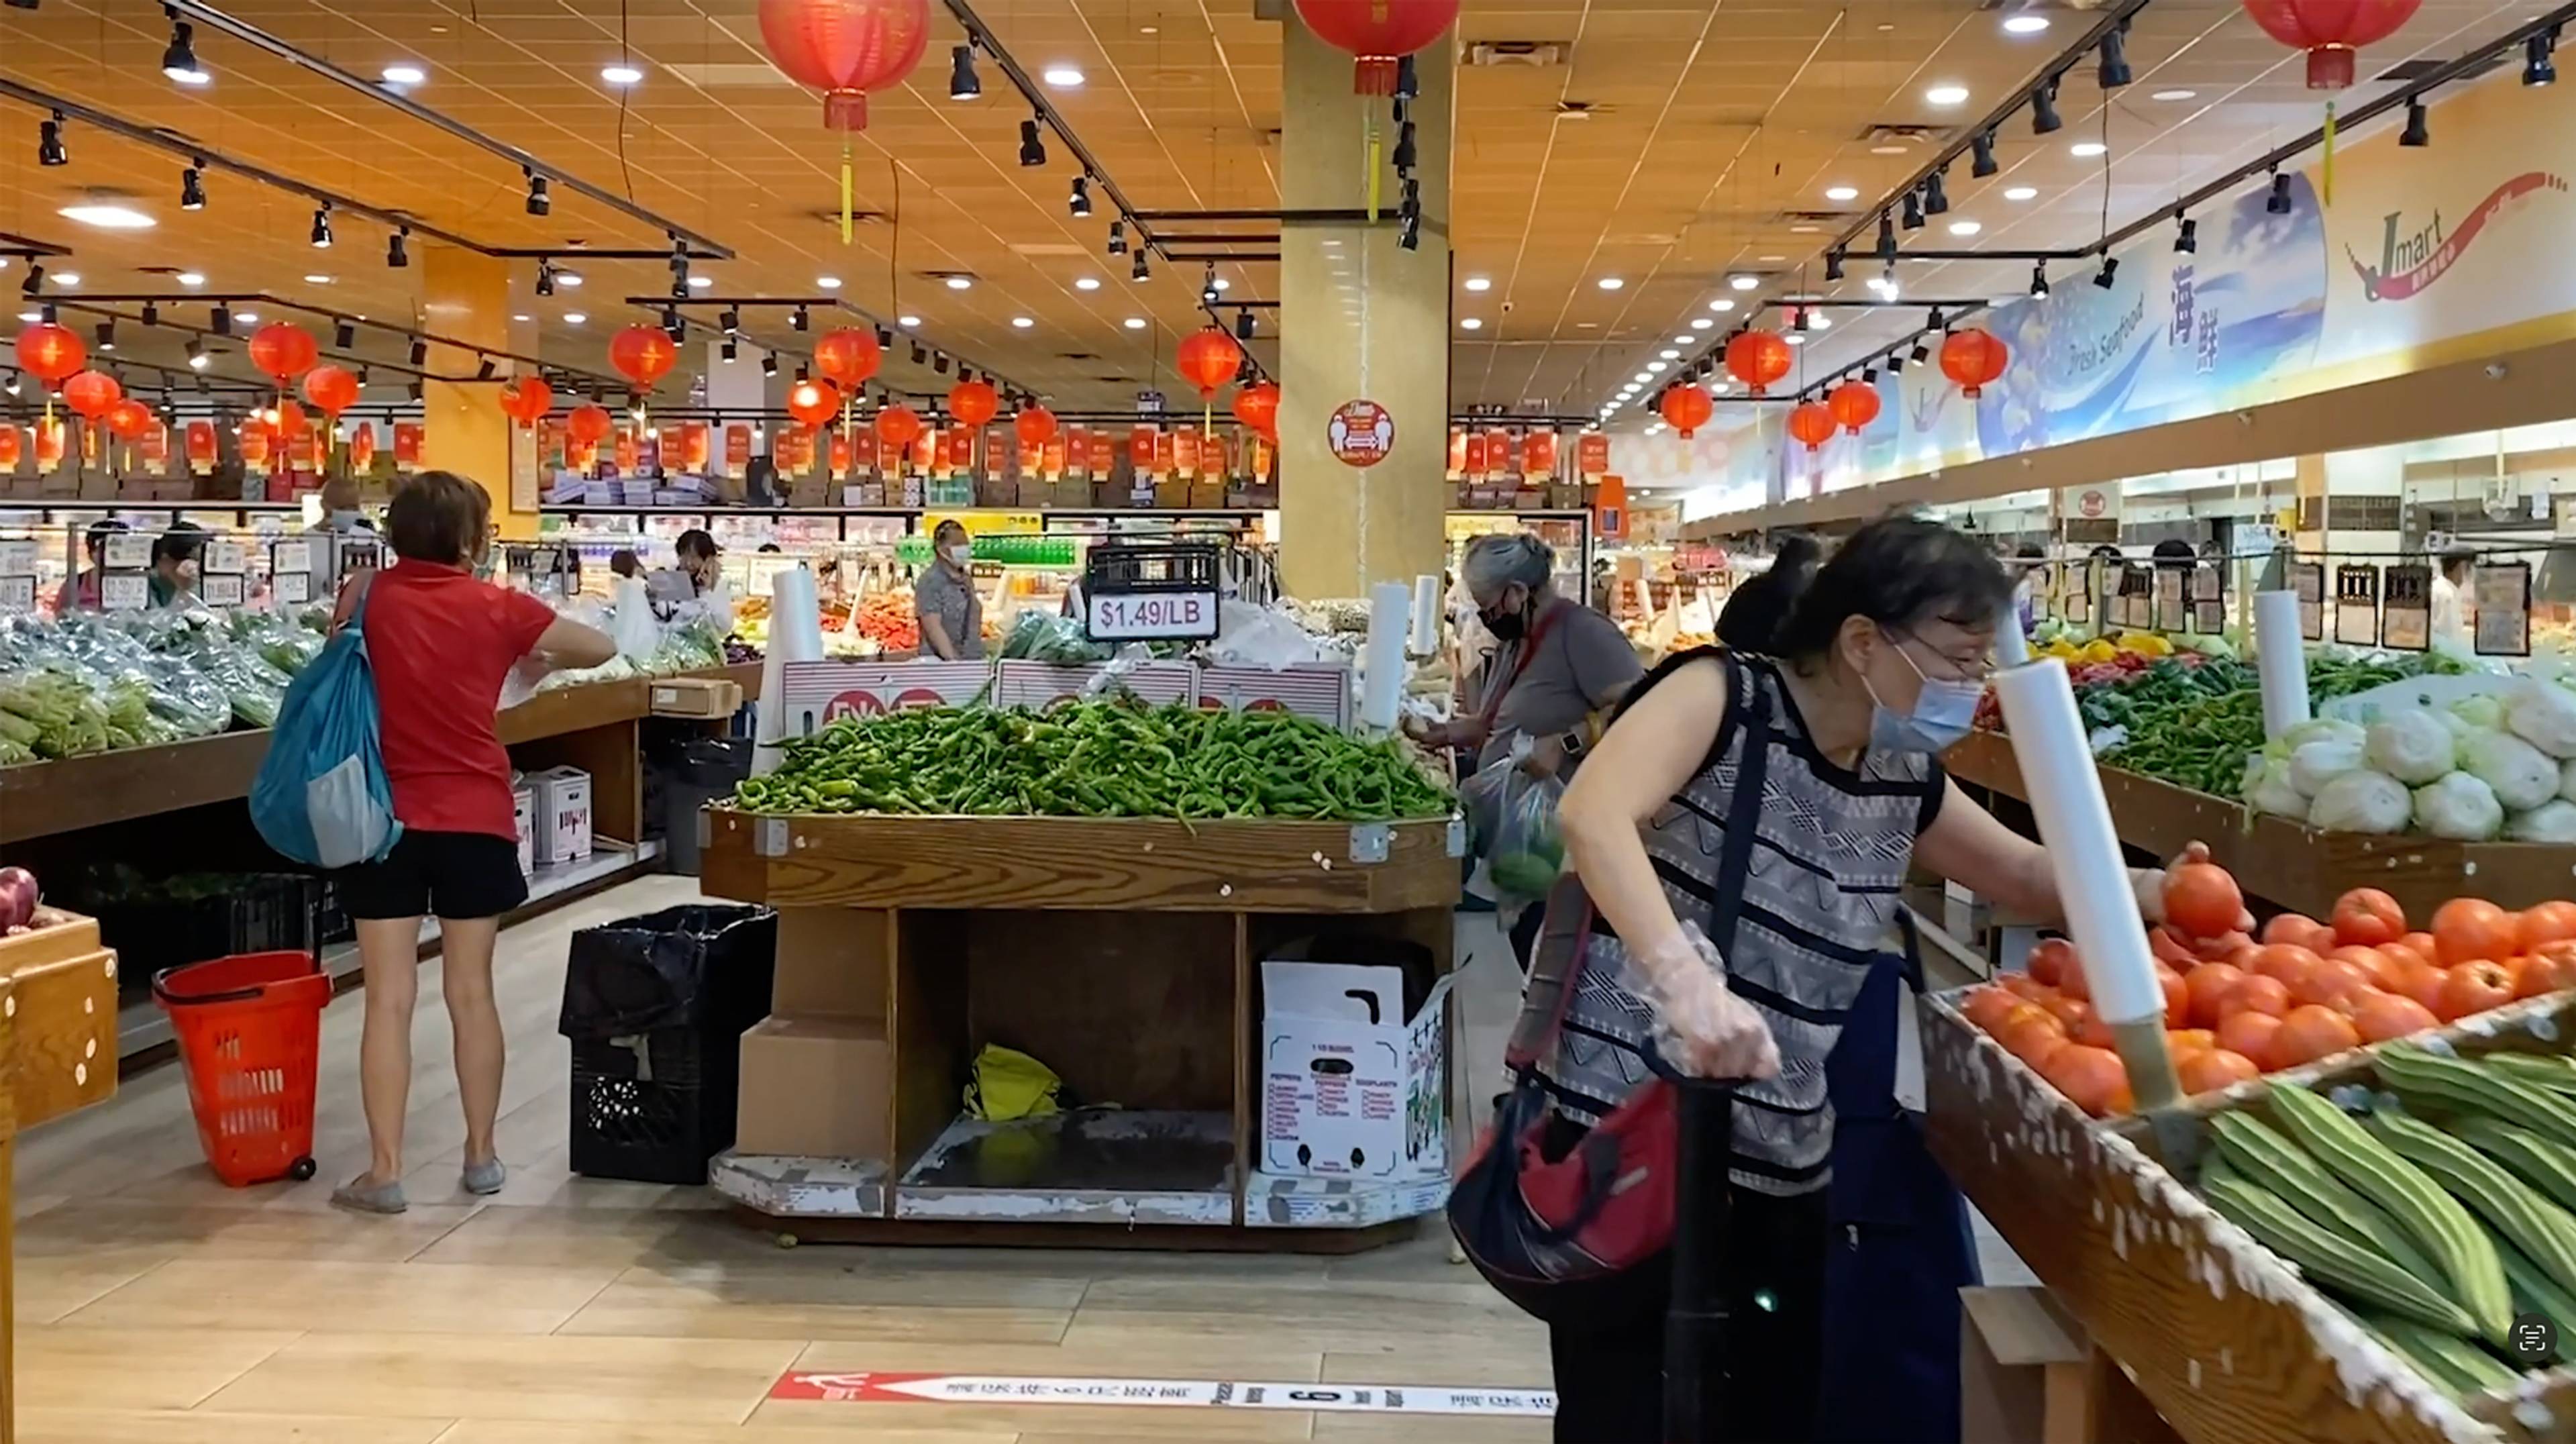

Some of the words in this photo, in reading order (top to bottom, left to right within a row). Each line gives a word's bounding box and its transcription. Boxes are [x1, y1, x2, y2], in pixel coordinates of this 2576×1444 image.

[2168, 264, 2218, 373] 海鮮
[1100, 600, 1200, 630] $1.49/LB
[1288, 1390, 1341, 1402] 6
